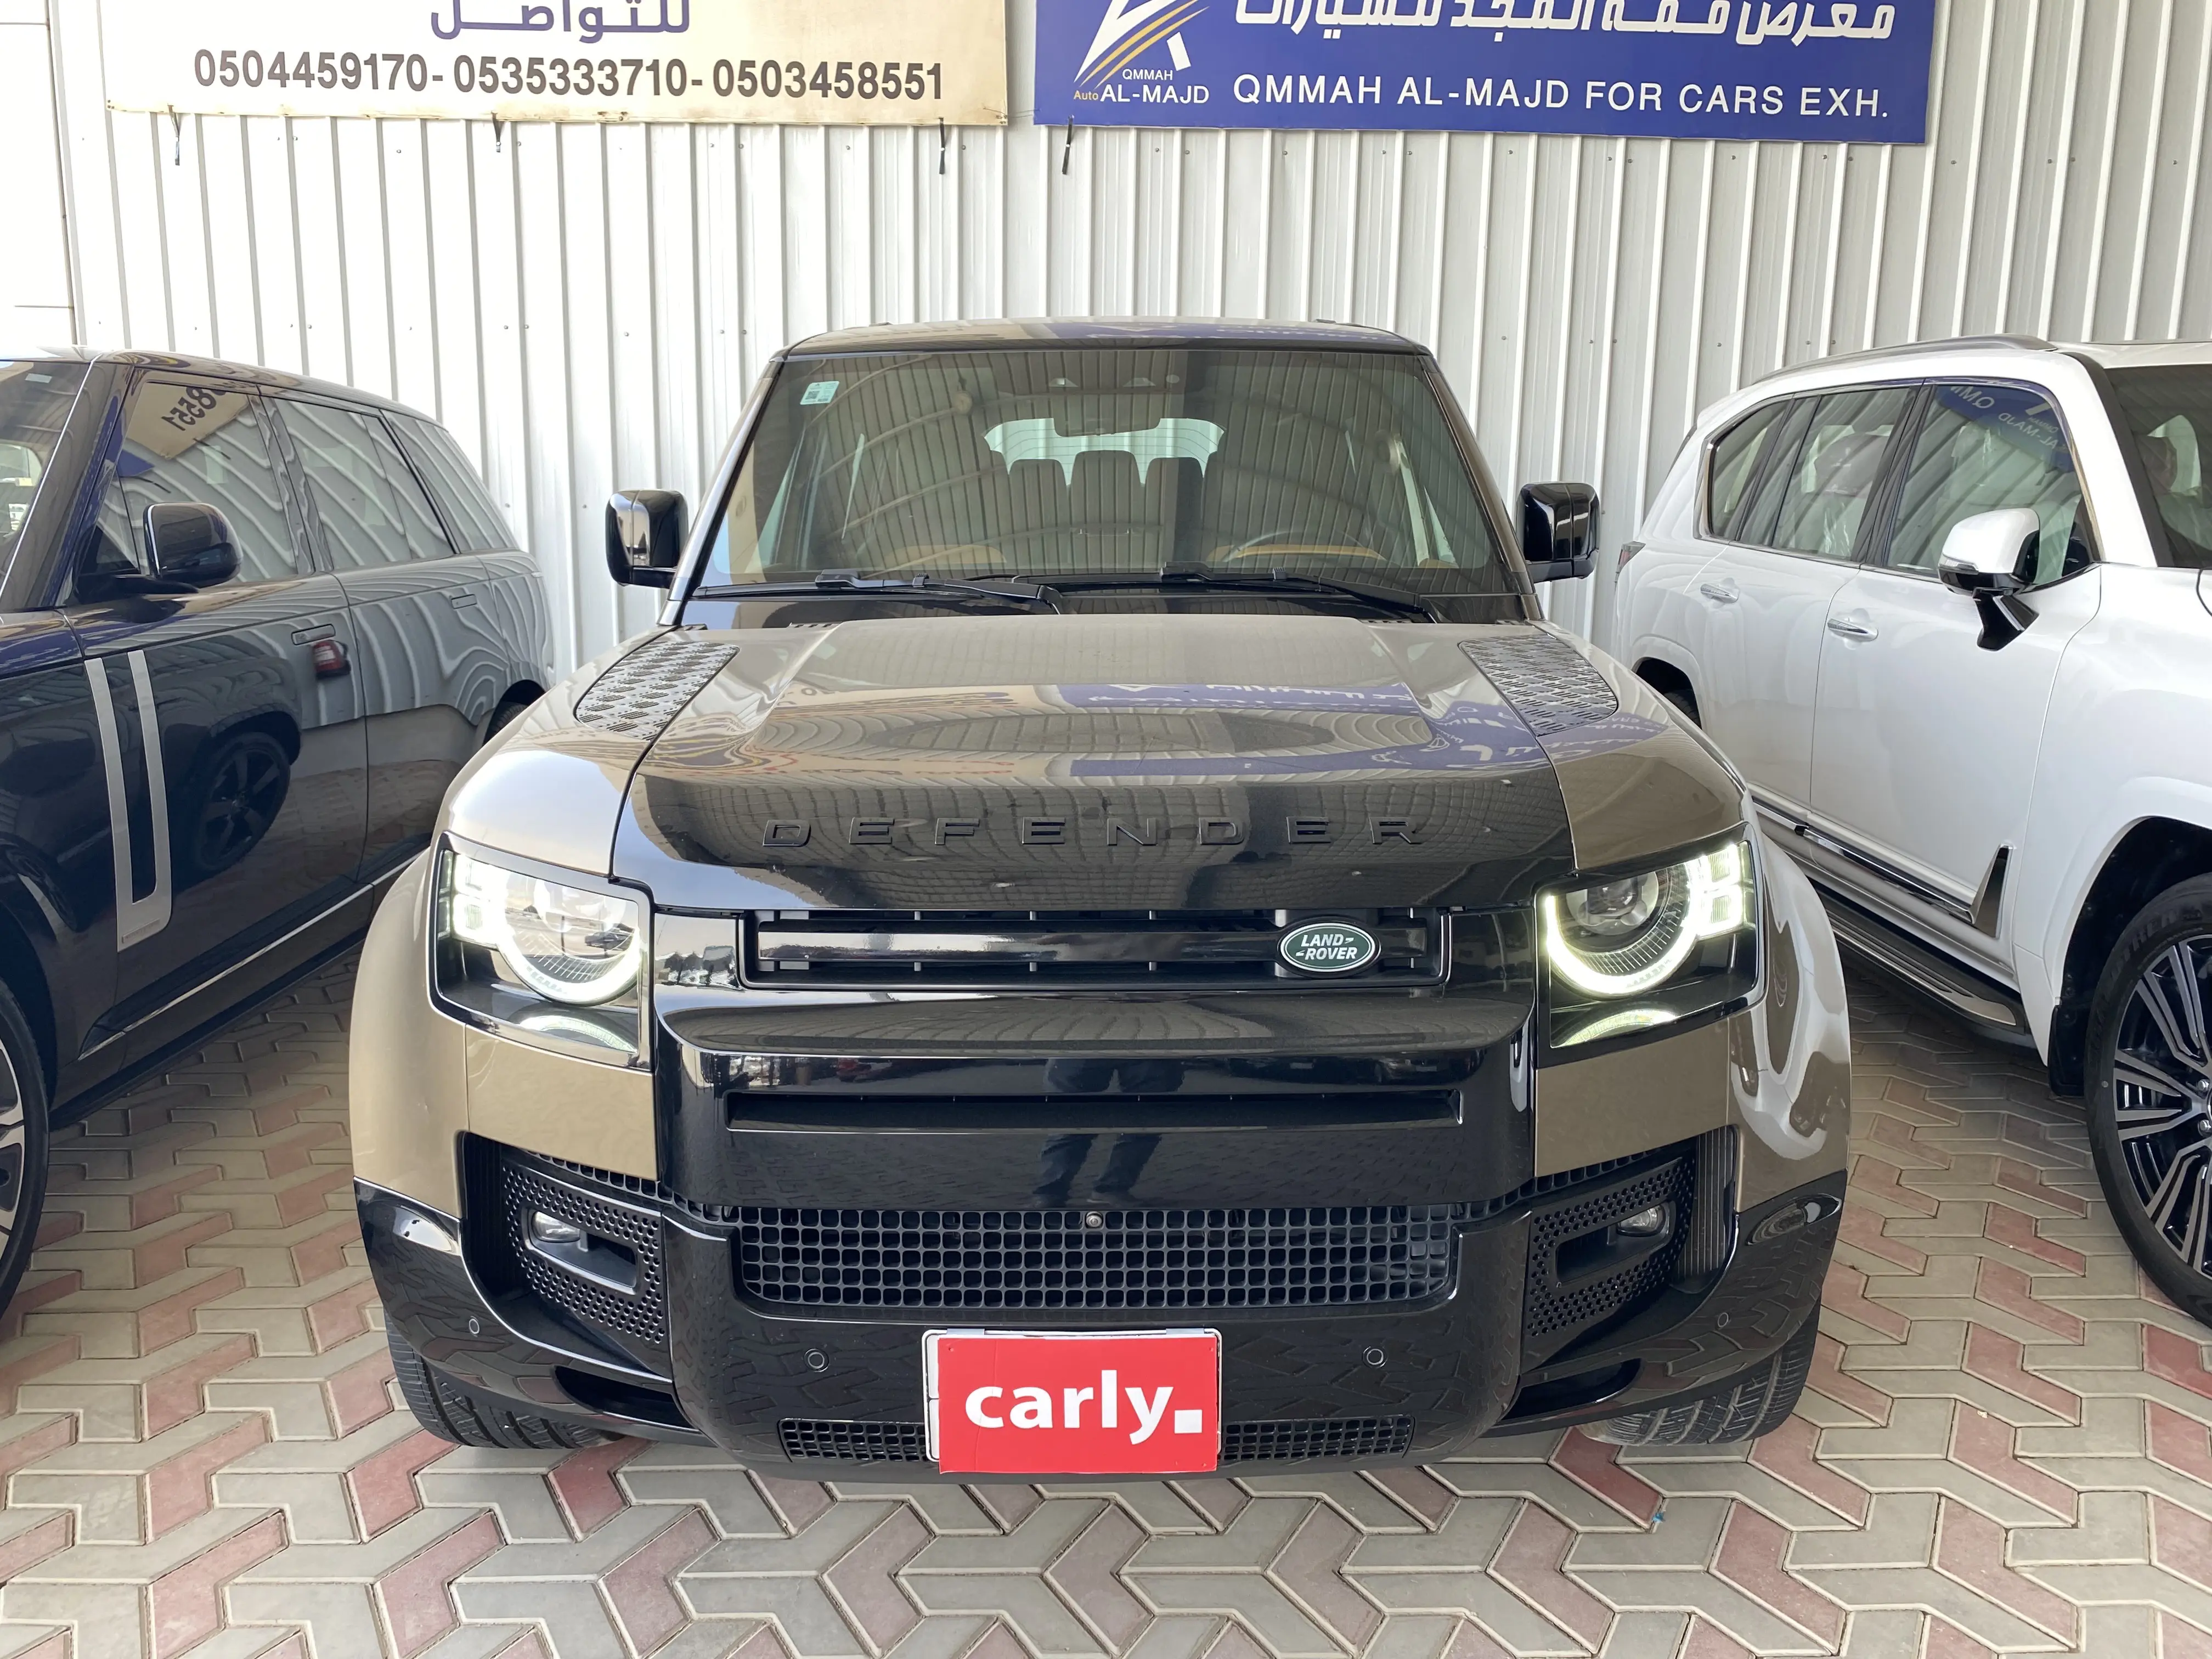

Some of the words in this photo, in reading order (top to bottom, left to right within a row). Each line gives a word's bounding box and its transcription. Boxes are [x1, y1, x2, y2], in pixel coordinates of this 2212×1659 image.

[431, 0, 690, 44] للتواصل
[194, 49, 444, 92] 0504459170-
[454, 55, 703, 97] 0535333710-
[713, 59, 942, 100] 0503458551
[1122, 69, 1173, 81] QMMAH
[1073, 90, 1098, 101] Auto
[1099, 83, 1210, 104] AL-MAJD
[1233, 74, 1381, 105] QMMAH
[1397, 77, 1569, 109] AL-MAJD
[1586, 81, 1663, 111] FOR
[1679, 84, 1784, 115] CARS
[1800, 88, 1888, 118] EXH.
[763, 816, 1422, 847] DEFENDER
[1301, 934, 1344, 947] LAND
[1305, 947, 1358, 960] ROVER
[965, 1369, 1203, 1445] carly.
